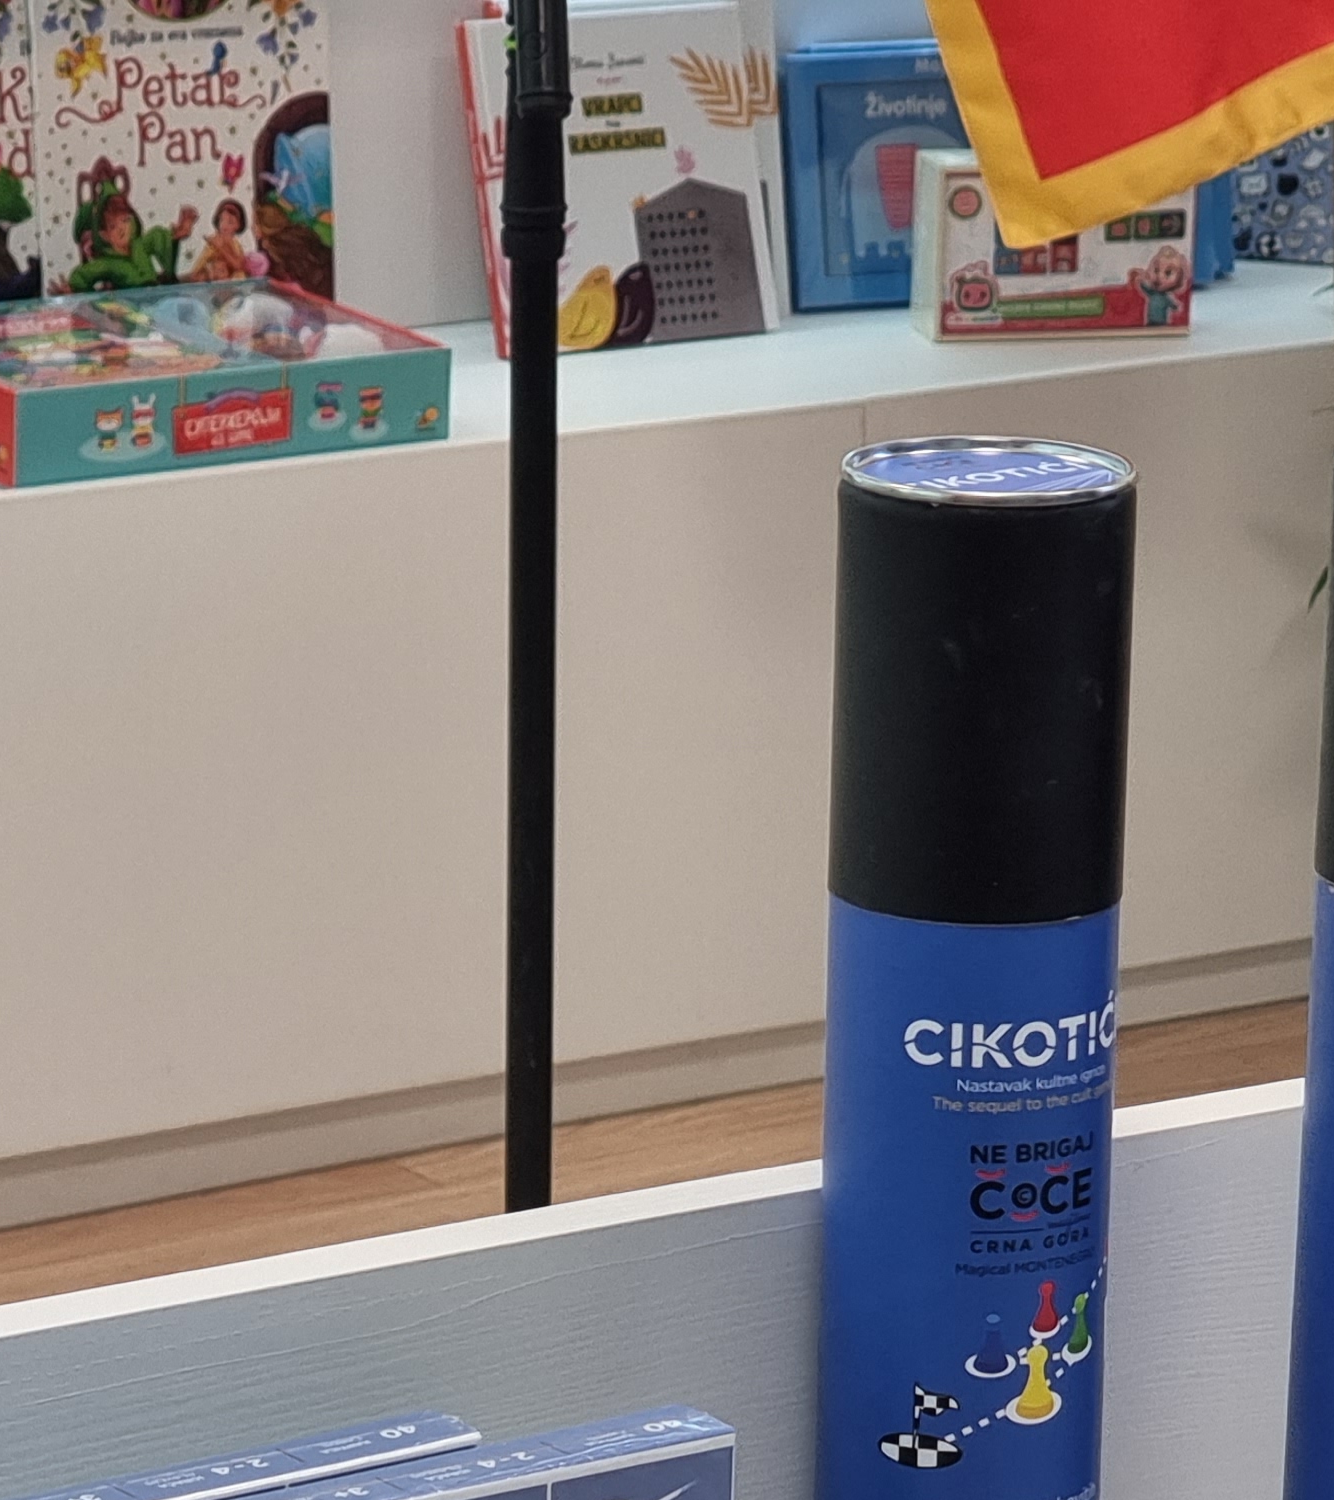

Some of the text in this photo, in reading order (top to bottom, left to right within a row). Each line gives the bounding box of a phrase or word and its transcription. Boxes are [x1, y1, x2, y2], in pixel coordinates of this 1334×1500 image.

[87, 57, 259, 125] Petar
[136, 109, 221, 167] Pan
[904, 989, 1116, 1068] CIKOTIĆ
[957, 1077, 1032, 1093] Nastavak
[933, 1095, 963, 1112] The
[968, 1098, 1021, 1114] sequel
[1026, 1096, 1042, 1110] to
[1046, 1092, 1069, 1108] the
[970, 1131, 1094, 1164] NE BRIGAJ
[970, 1226, 1090, 1254] CRNA GORA
[955, 1262, 1010, 1278] Magical
[380, 1424, 417, 1440] 40
[643, 1419, 682, 1432] 40
[211, 1458, 269, 1475] 2-4
[477, 1452, 534, 1468] 2-4
